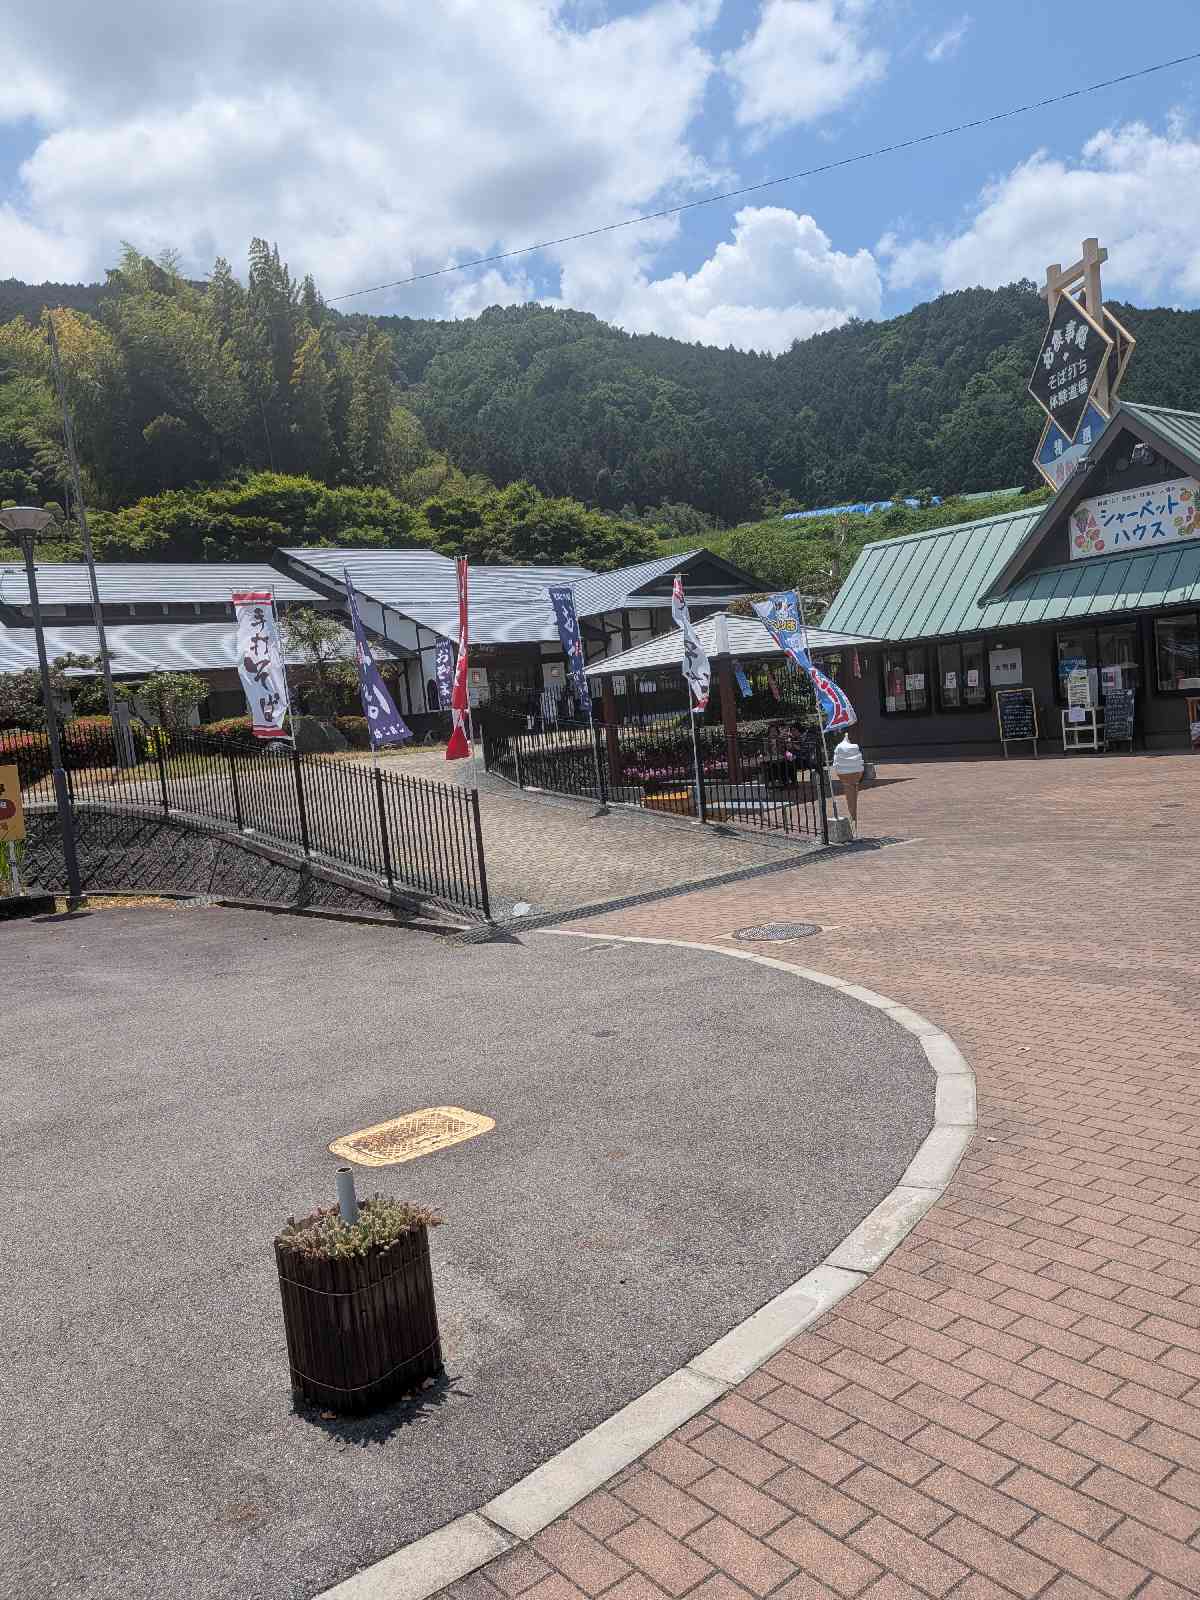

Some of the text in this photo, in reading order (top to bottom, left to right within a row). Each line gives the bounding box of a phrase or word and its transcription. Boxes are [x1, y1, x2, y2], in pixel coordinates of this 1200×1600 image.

[1048, 358, 1087, 390] そば打ち
[1099, 495, 1179, 527] シャーベット
[1115, 521, 1165, 544] ハウス
